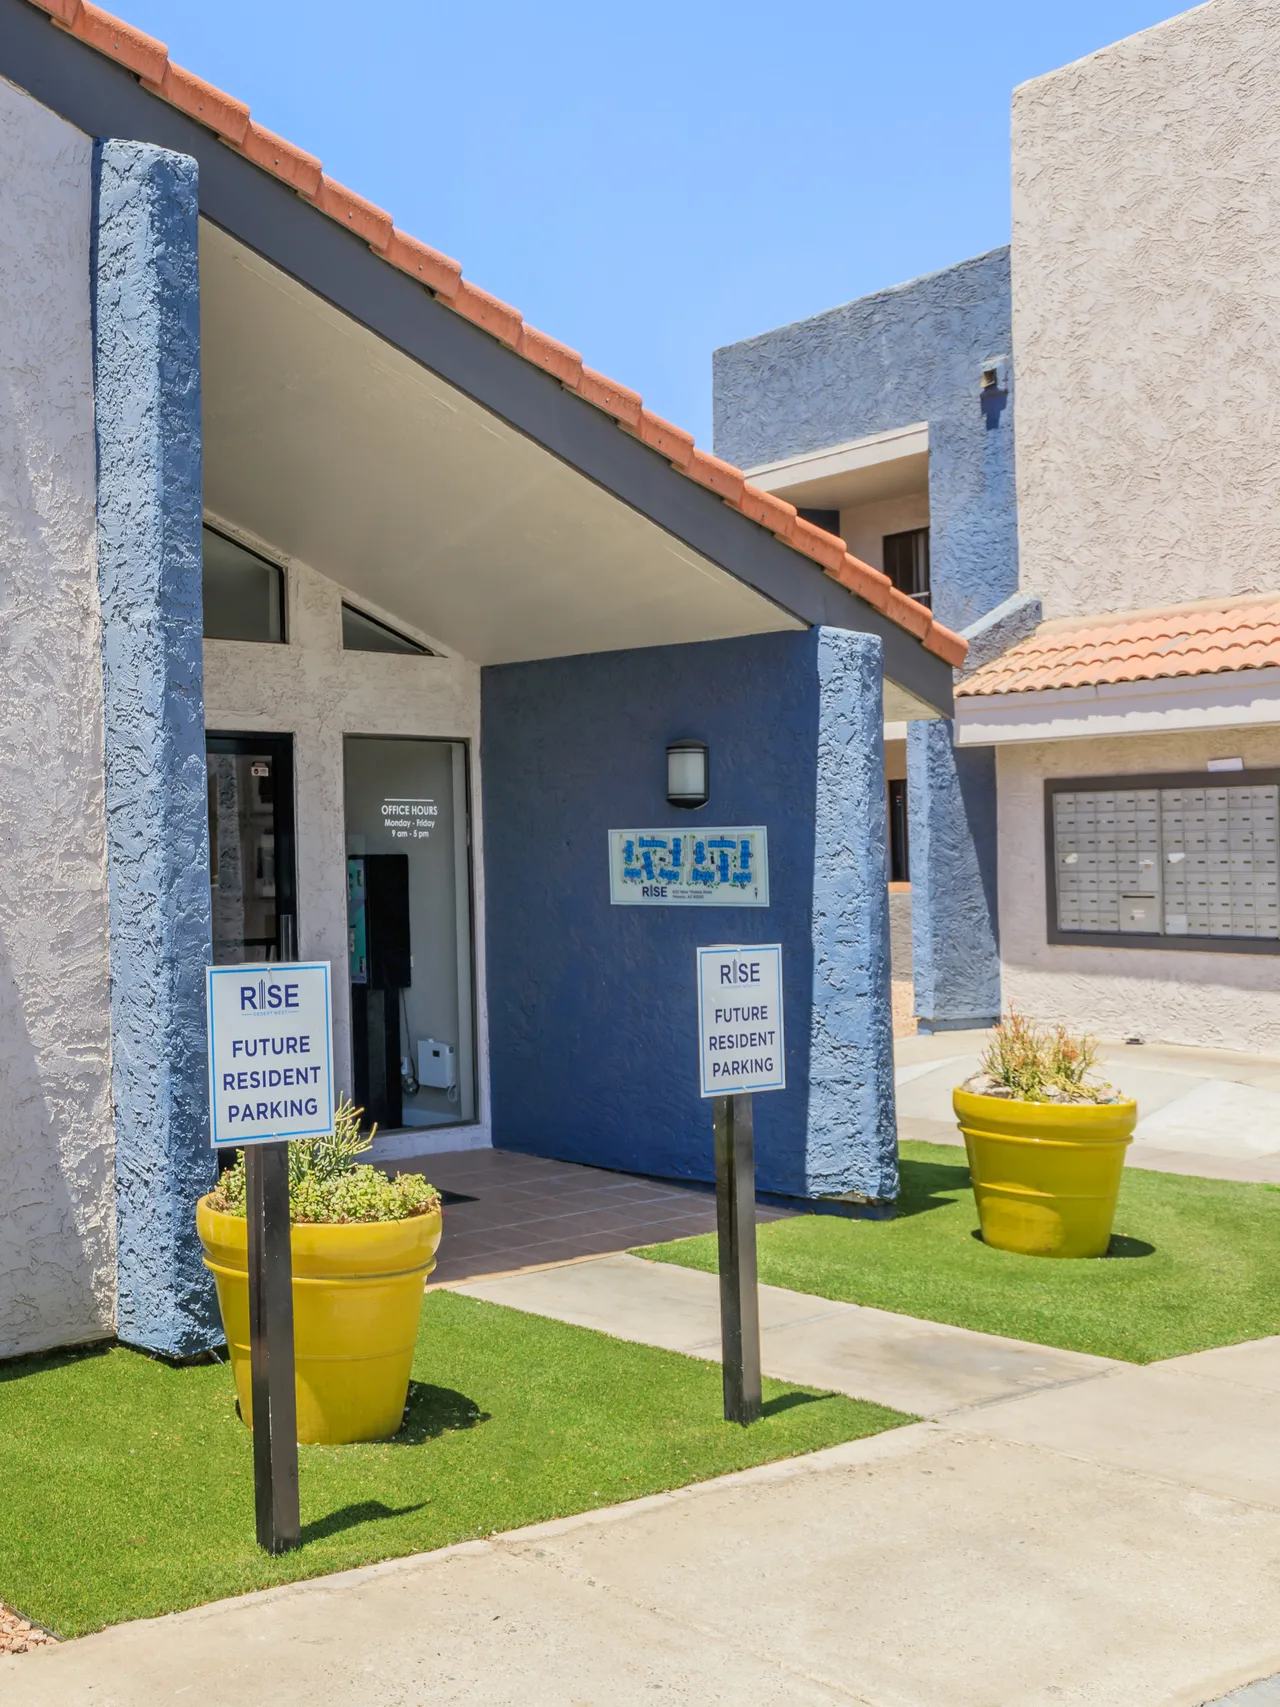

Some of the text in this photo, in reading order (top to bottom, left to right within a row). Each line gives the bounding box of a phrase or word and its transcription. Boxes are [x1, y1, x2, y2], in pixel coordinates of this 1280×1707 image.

[381, 805, 438, 816] OFFICE HOURS
[384, 819, 411, 828] Monday
[416, 819, 435, 828] Friday
[392, 829, 396, 837] 9
[413, 829, 418, 837] 5
[418, 831, 429, 839] pm
[642, 885, 668, 898] RISE
[720, 958, 761, 984] RISE
[240, 979, 300, 1011] RISE
[715, 1005, 768, 1024] FUTURE
[232, 1035, 310, 1058] FUTURE
[709, 1031, 775, 1051] RESIDENT
[712, 1057, 774, 1077] PARKING
[223, 1066, 321, 1091] RESIDENT
[228, 1098, 318, 1123] PARKING
